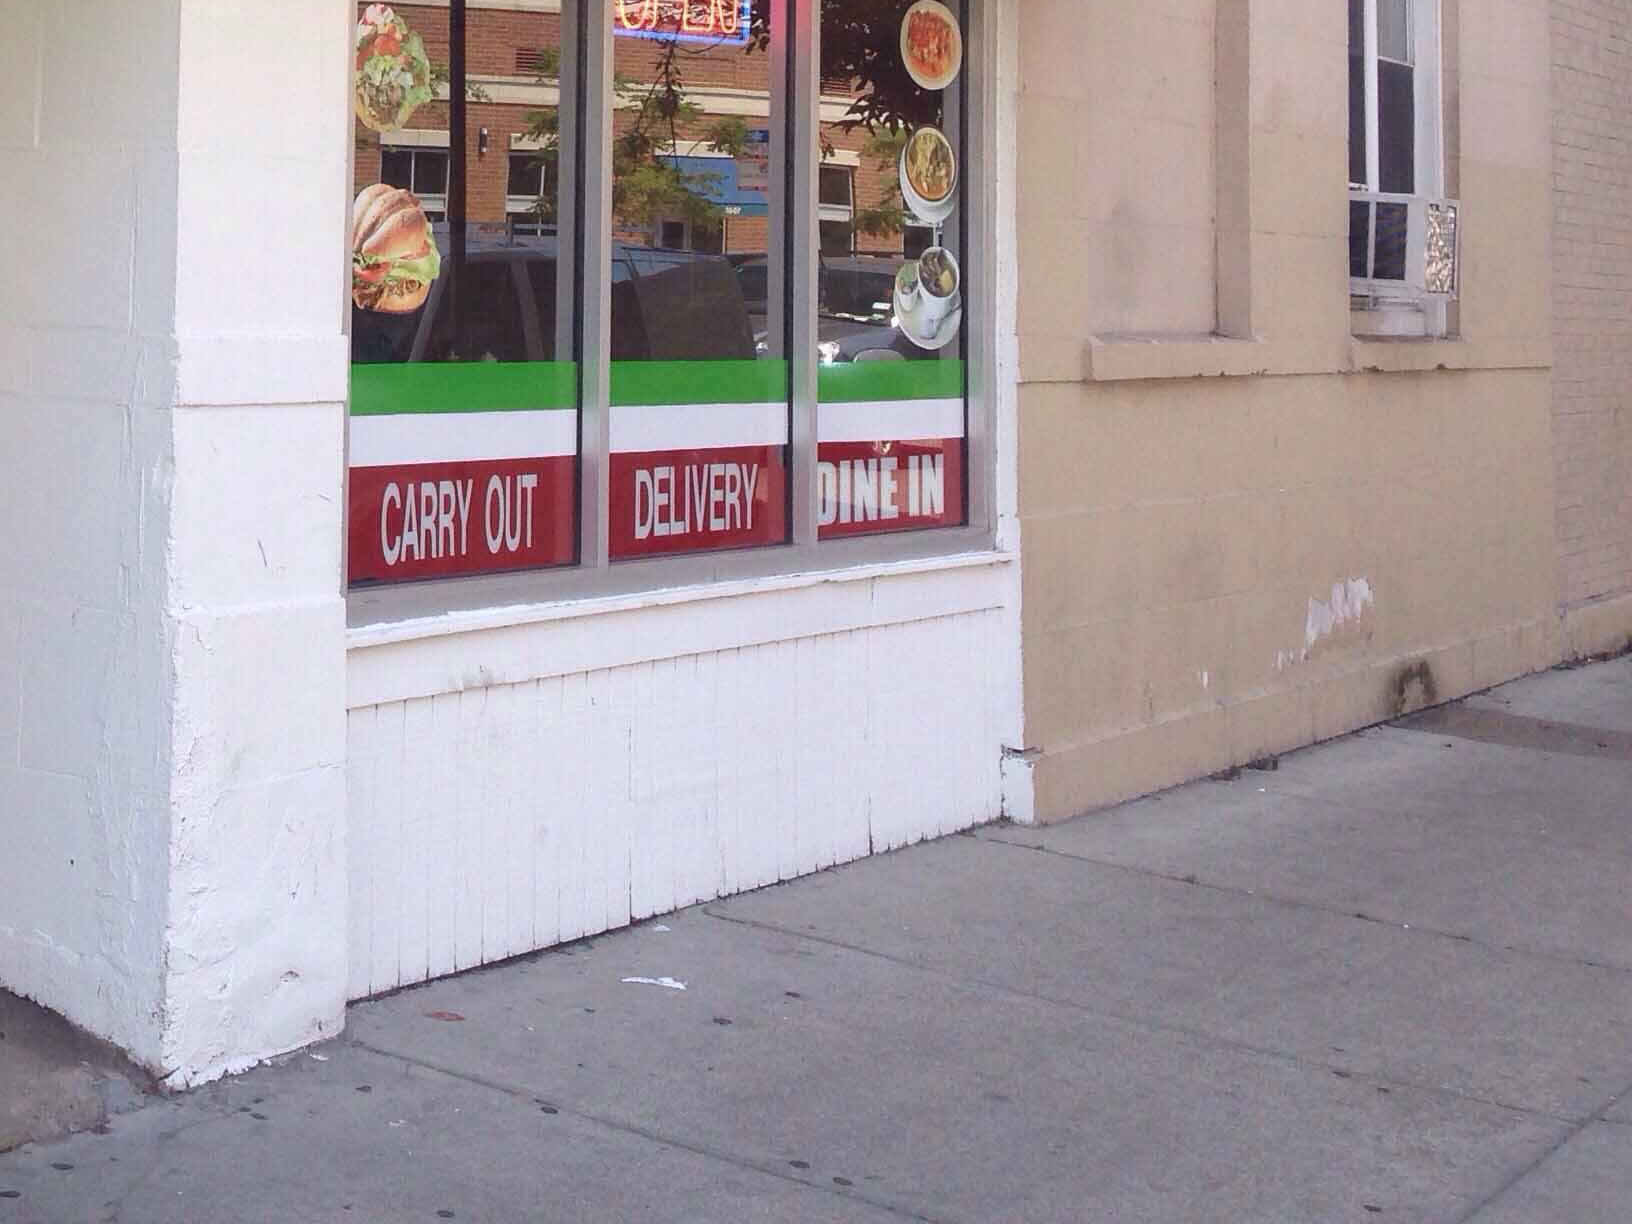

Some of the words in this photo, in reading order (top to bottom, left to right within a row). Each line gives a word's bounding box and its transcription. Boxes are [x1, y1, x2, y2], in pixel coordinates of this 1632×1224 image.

[380, 478, 472, 567] CARRY
[485, 474, 538, 554] OUT
[634, 463, 759, 539] DELIVERY
[817, 456, 899, 526] DINE
[909, 453, 945, 515] IN
